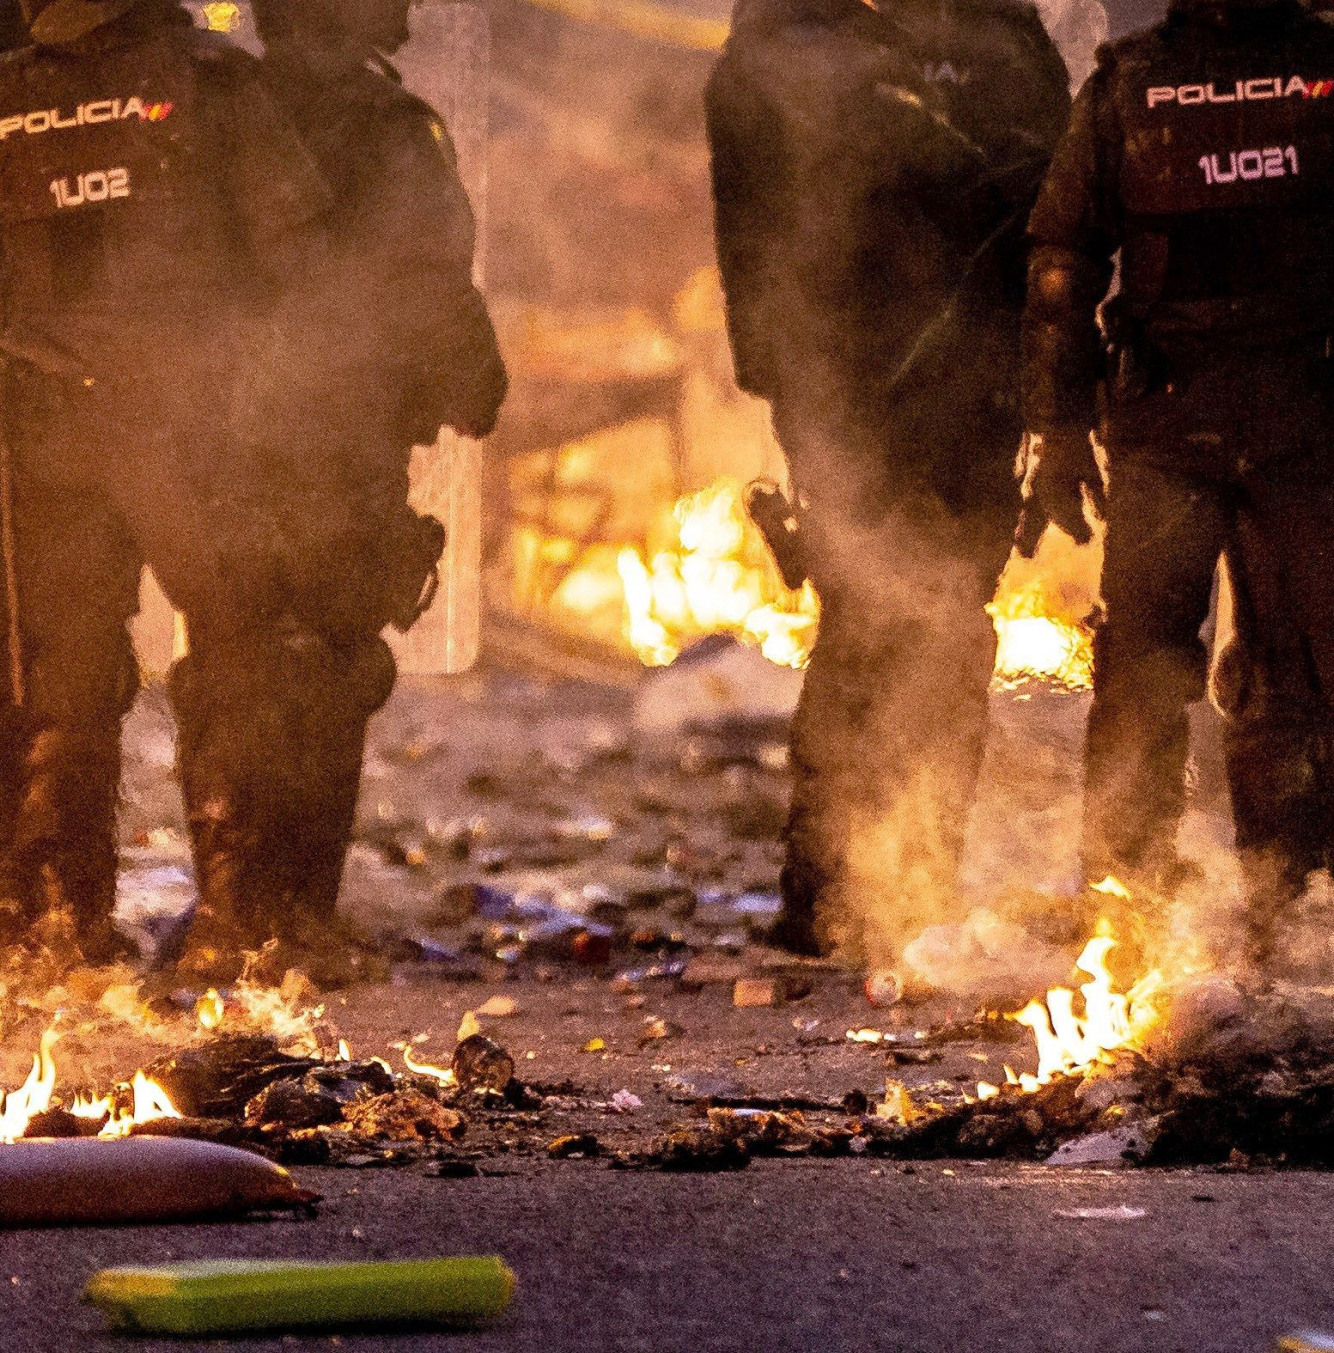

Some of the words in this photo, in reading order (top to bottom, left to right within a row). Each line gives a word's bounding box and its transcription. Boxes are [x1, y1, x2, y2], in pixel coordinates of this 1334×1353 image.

[1147, 75, 1310, 108] POLICIA
[1198, 145, 1299, 185] 1U021
[50, 167, 130, 207] 1U02
